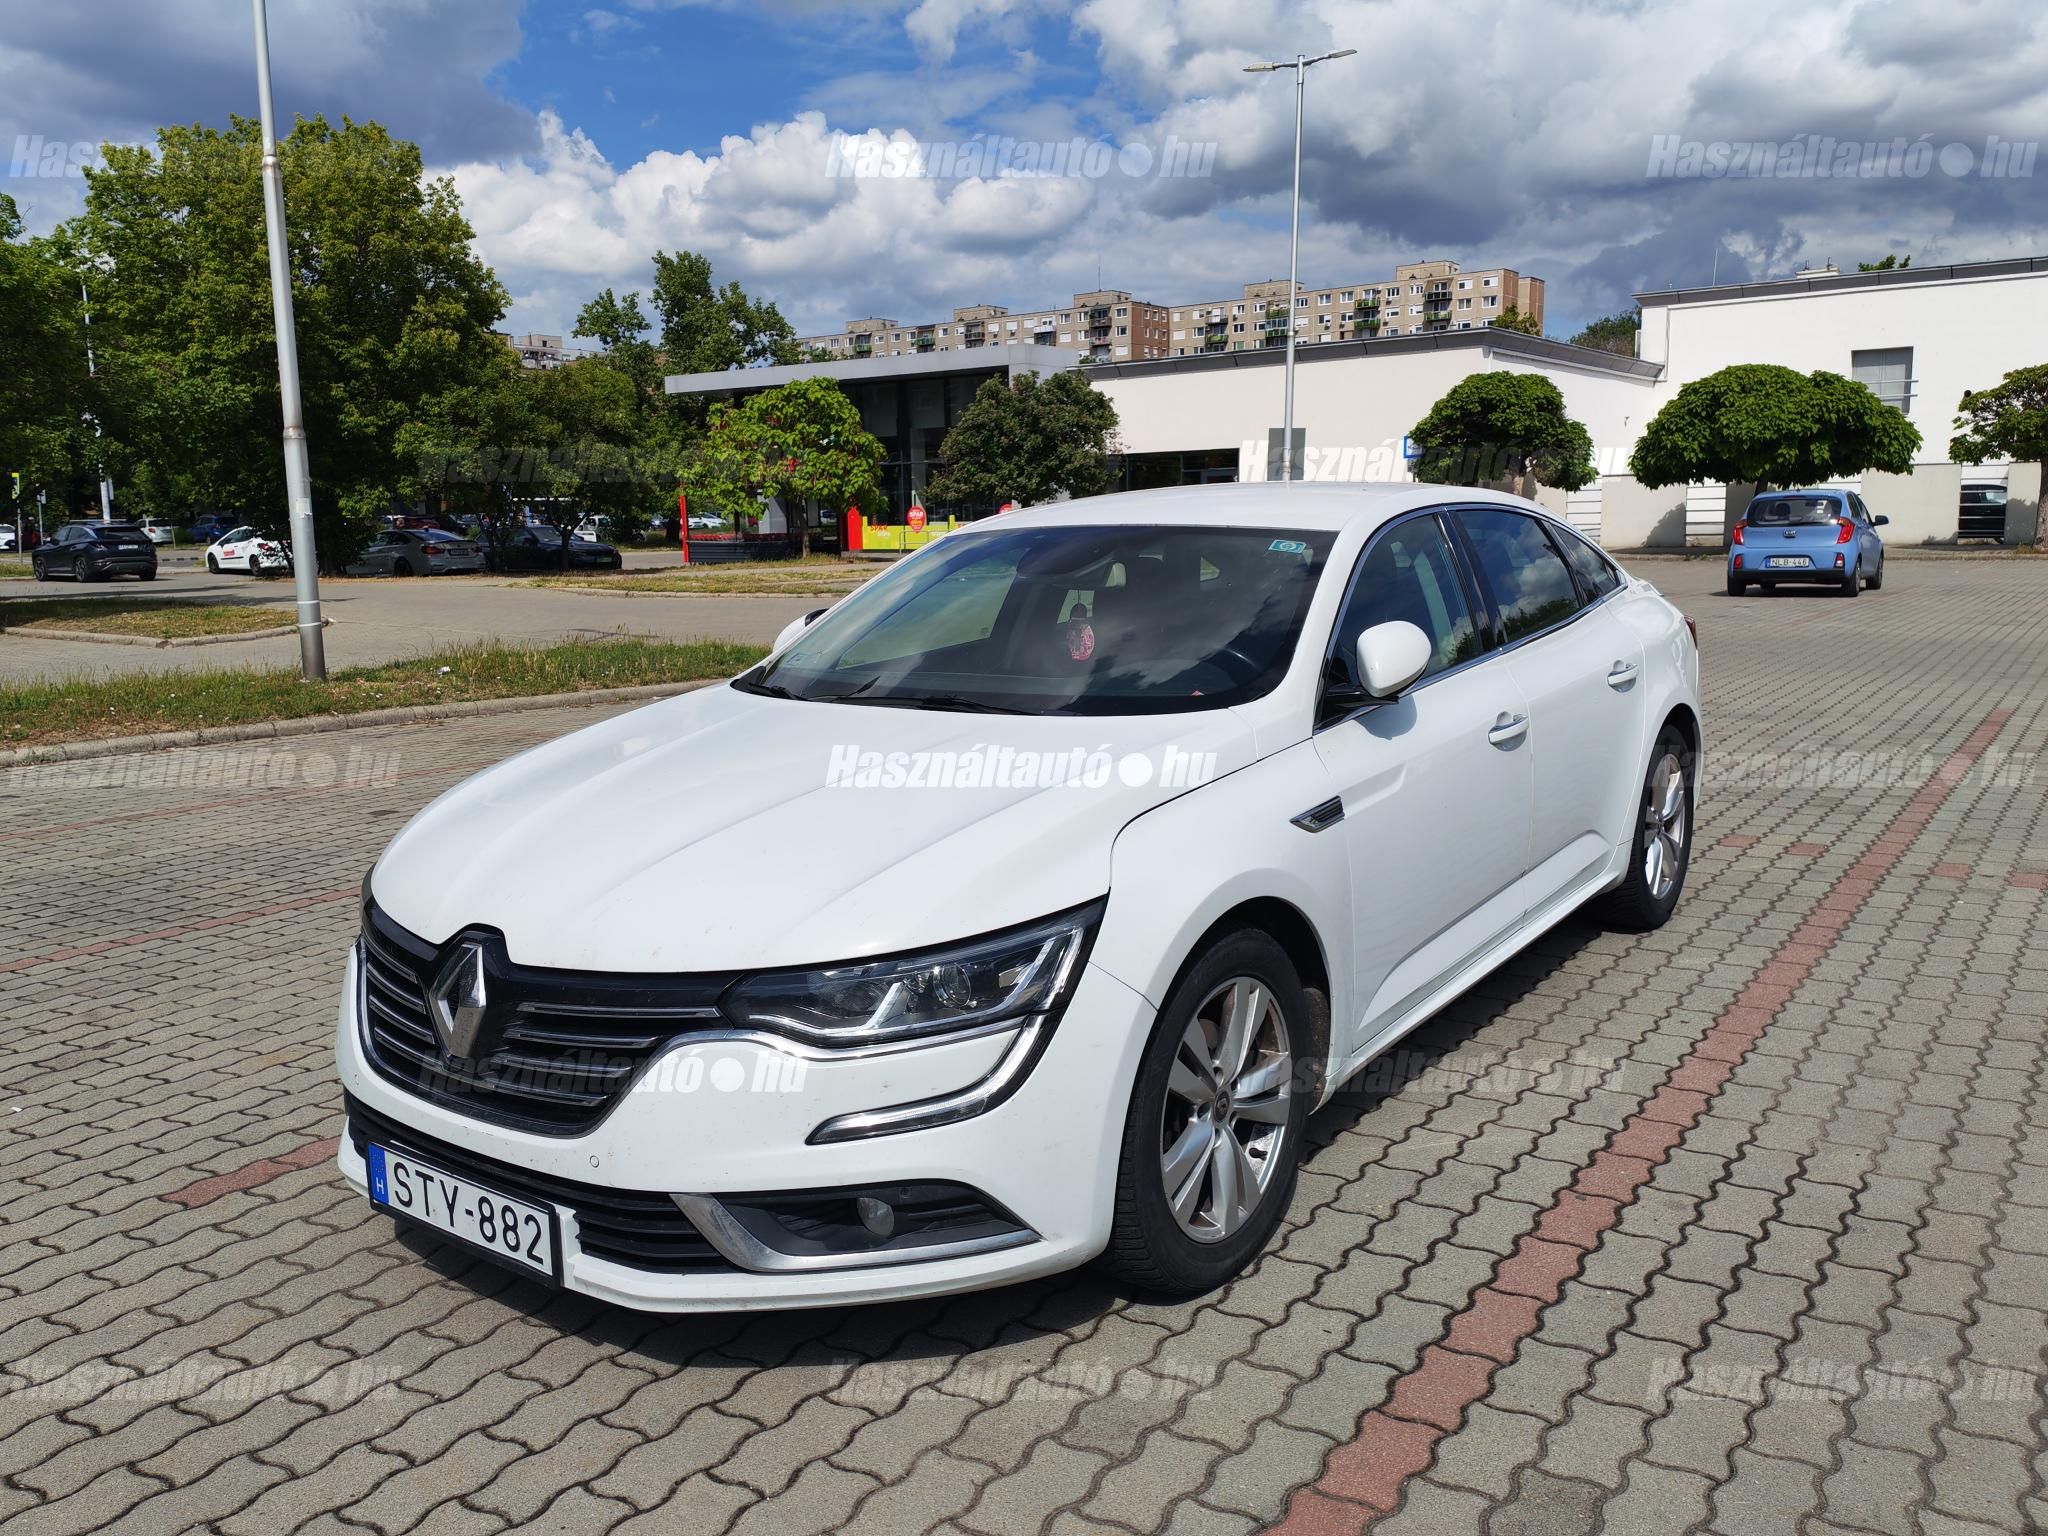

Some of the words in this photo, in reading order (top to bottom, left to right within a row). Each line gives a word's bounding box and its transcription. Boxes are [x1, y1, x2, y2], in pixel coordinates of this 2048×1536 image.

[1772, 559, 1808, 567] NLB-446
[376, 1176, 386, 1195] H
[394, 1161, 544, 1265] STY-882
